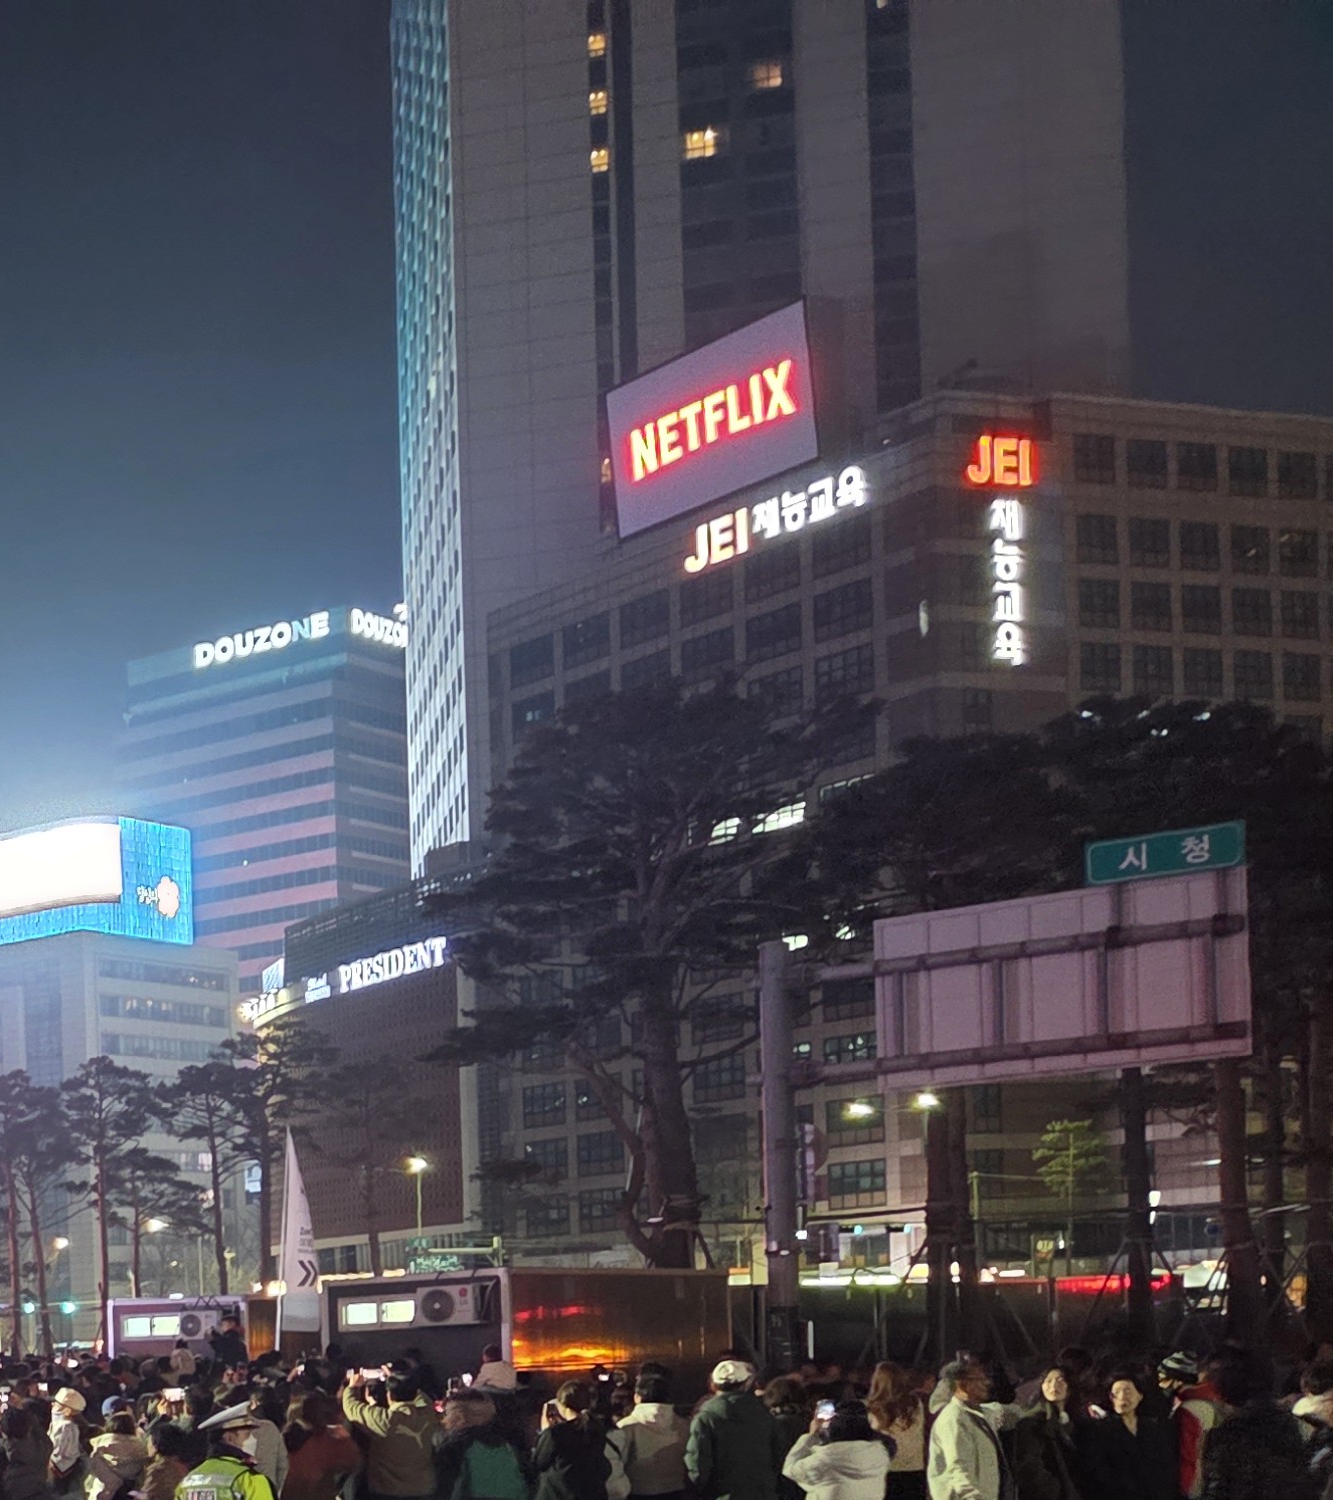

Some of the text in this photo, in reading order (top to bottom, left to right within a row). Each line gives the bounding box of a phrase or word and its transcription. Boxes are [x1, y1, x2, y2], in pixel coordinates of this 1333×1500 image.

[630, 359, 797, 482] NETFLIX
[967, 435, 1032, 486] JEI
[684, 465, 869, 573] JEI 재능교육
[989, 499, 1025, 667] 재능교육
[194, 611, 330, 669] DOUZONE
[1118, 833, 1210, 872] 시청
[339, 936, 447, 994] PRESIDENT
